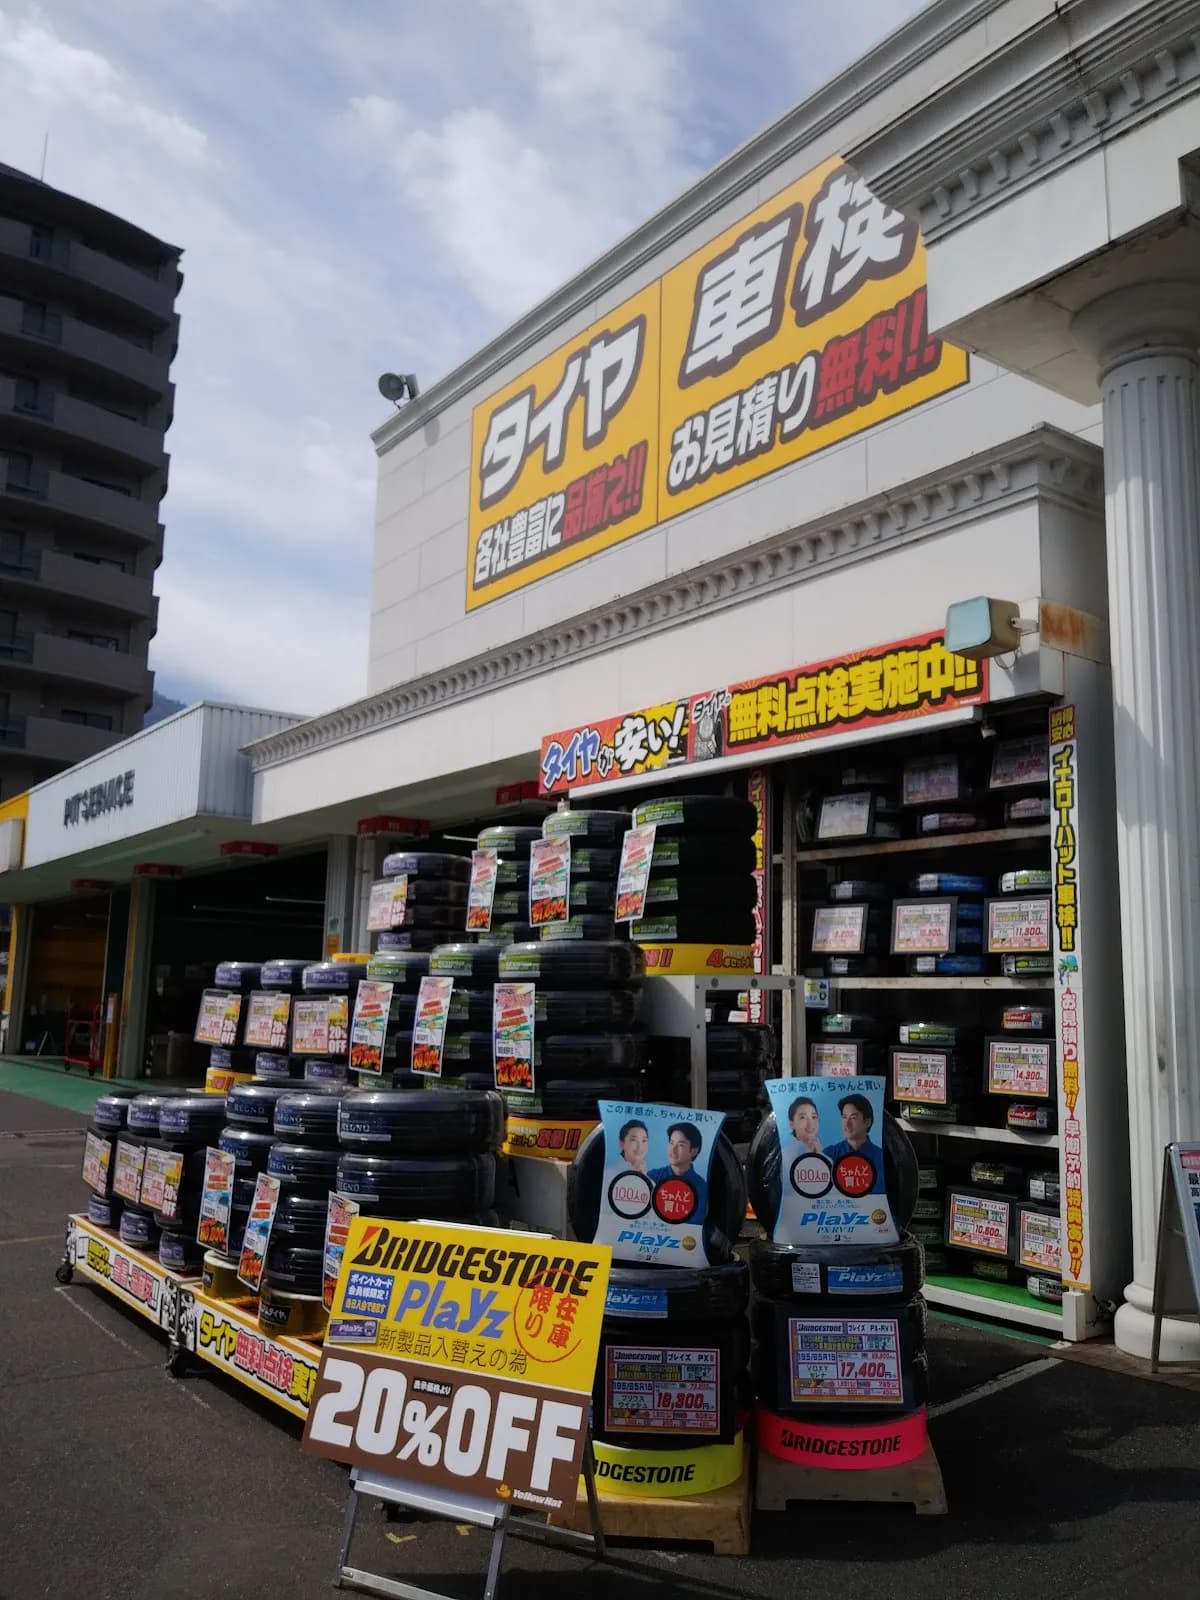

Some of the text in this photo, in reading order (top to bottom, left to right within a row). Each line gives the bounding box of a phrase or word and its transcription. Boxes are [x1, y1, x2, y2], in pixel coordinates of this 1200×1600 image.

[481, 325, 640, 500] タイヤ
[1053, 744, 1078, 951] イエローハット車検!!
[328, 1039, 348, 1055] OFF
[329, 1026, 348, 1039] 20%
[839, 1166, 871, 1177] ちゃんと
[660, 1189, 691, 1203] ちゃんと
[800, 1211, 870, 1226] Playz
[617, 1230, 681, 1249] Playz
[351, 1225, 599, 1297] BRIDGESTONE
[838, 1272, 881, 1282] Playz
[394, 1279, 512, 1339] Playz
[525, 1284, 555, 1338] 限り
[547, 1293, 580, 1350] 在庫
[378, 1326, 529, 1375] 新製品入替えの為
[779, 1428, 901, 1457] BRIDGESTONE
